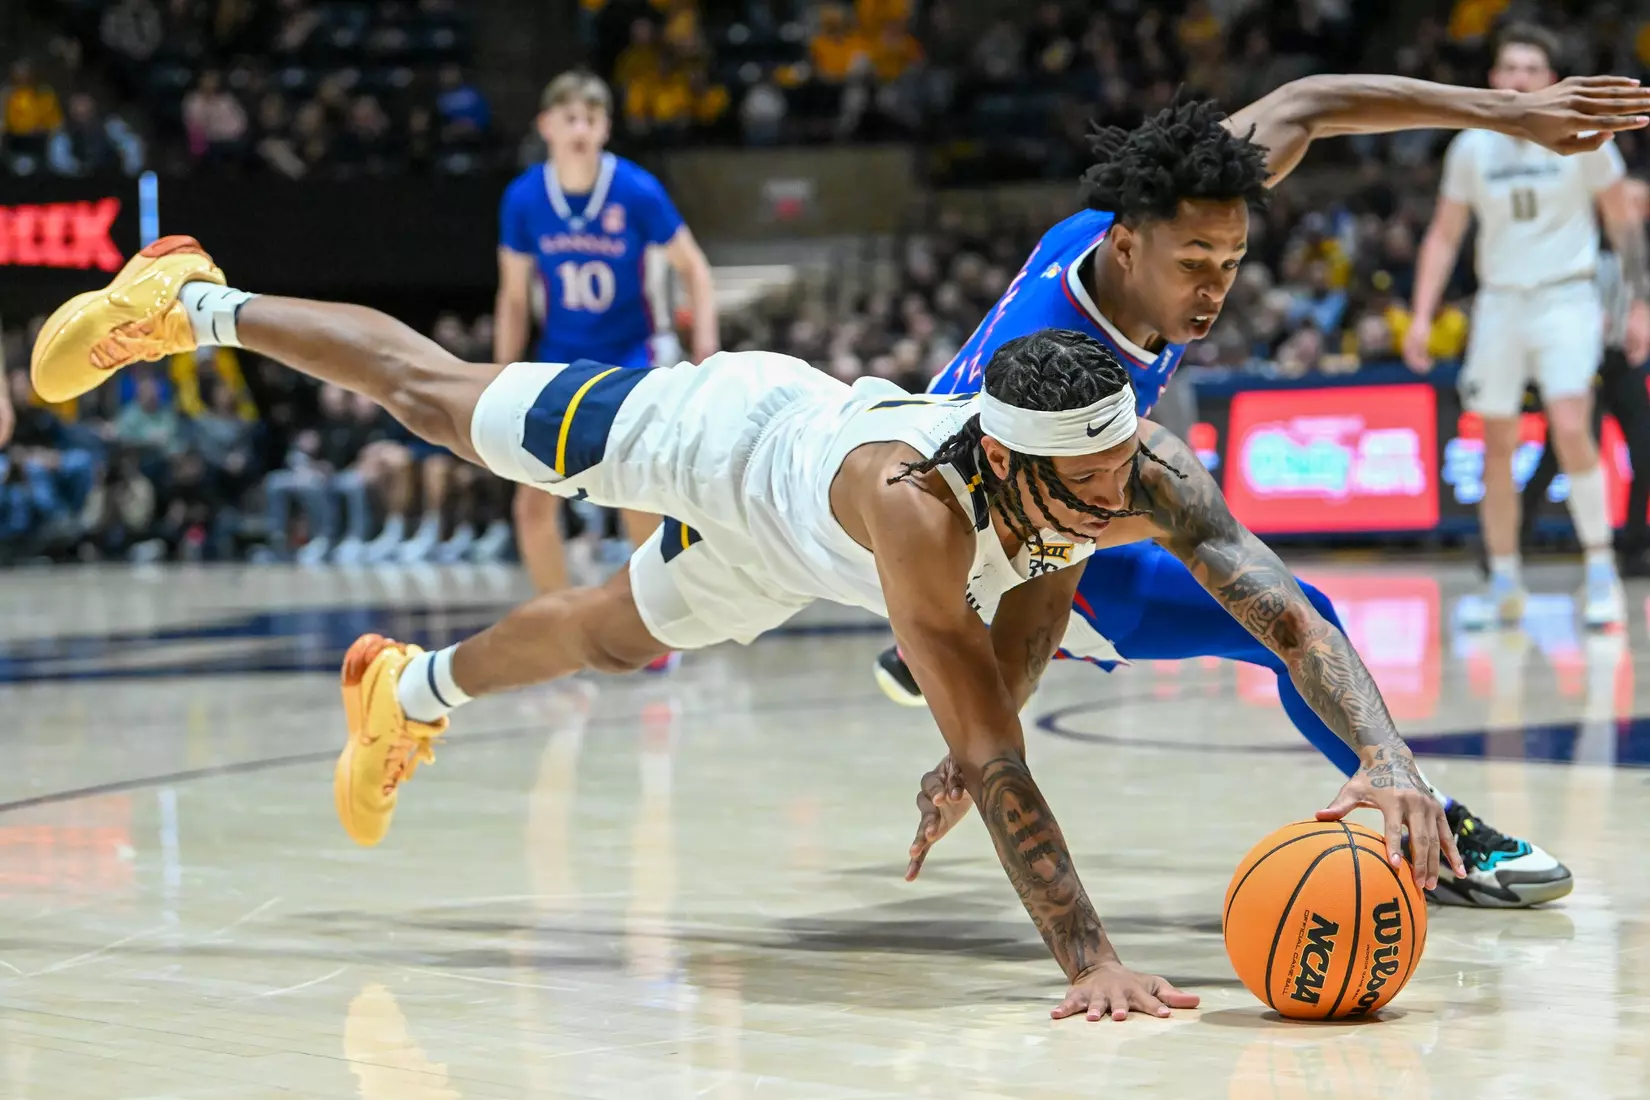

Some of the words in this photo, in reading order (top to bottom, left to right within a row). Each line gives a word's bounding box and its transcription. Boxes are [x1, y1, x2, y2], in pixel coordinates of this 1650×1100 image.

[557, 259, 616, 314] 10
[1294, 909, 1310, 950] OFFICIAL
[1288, 952, 1299, 977] GAME
[1290, 912, 1340, 1005] NCAA
[1346, 896, 1402, 1018] Wilson
[1282, 977, 1293, 996] BALL
